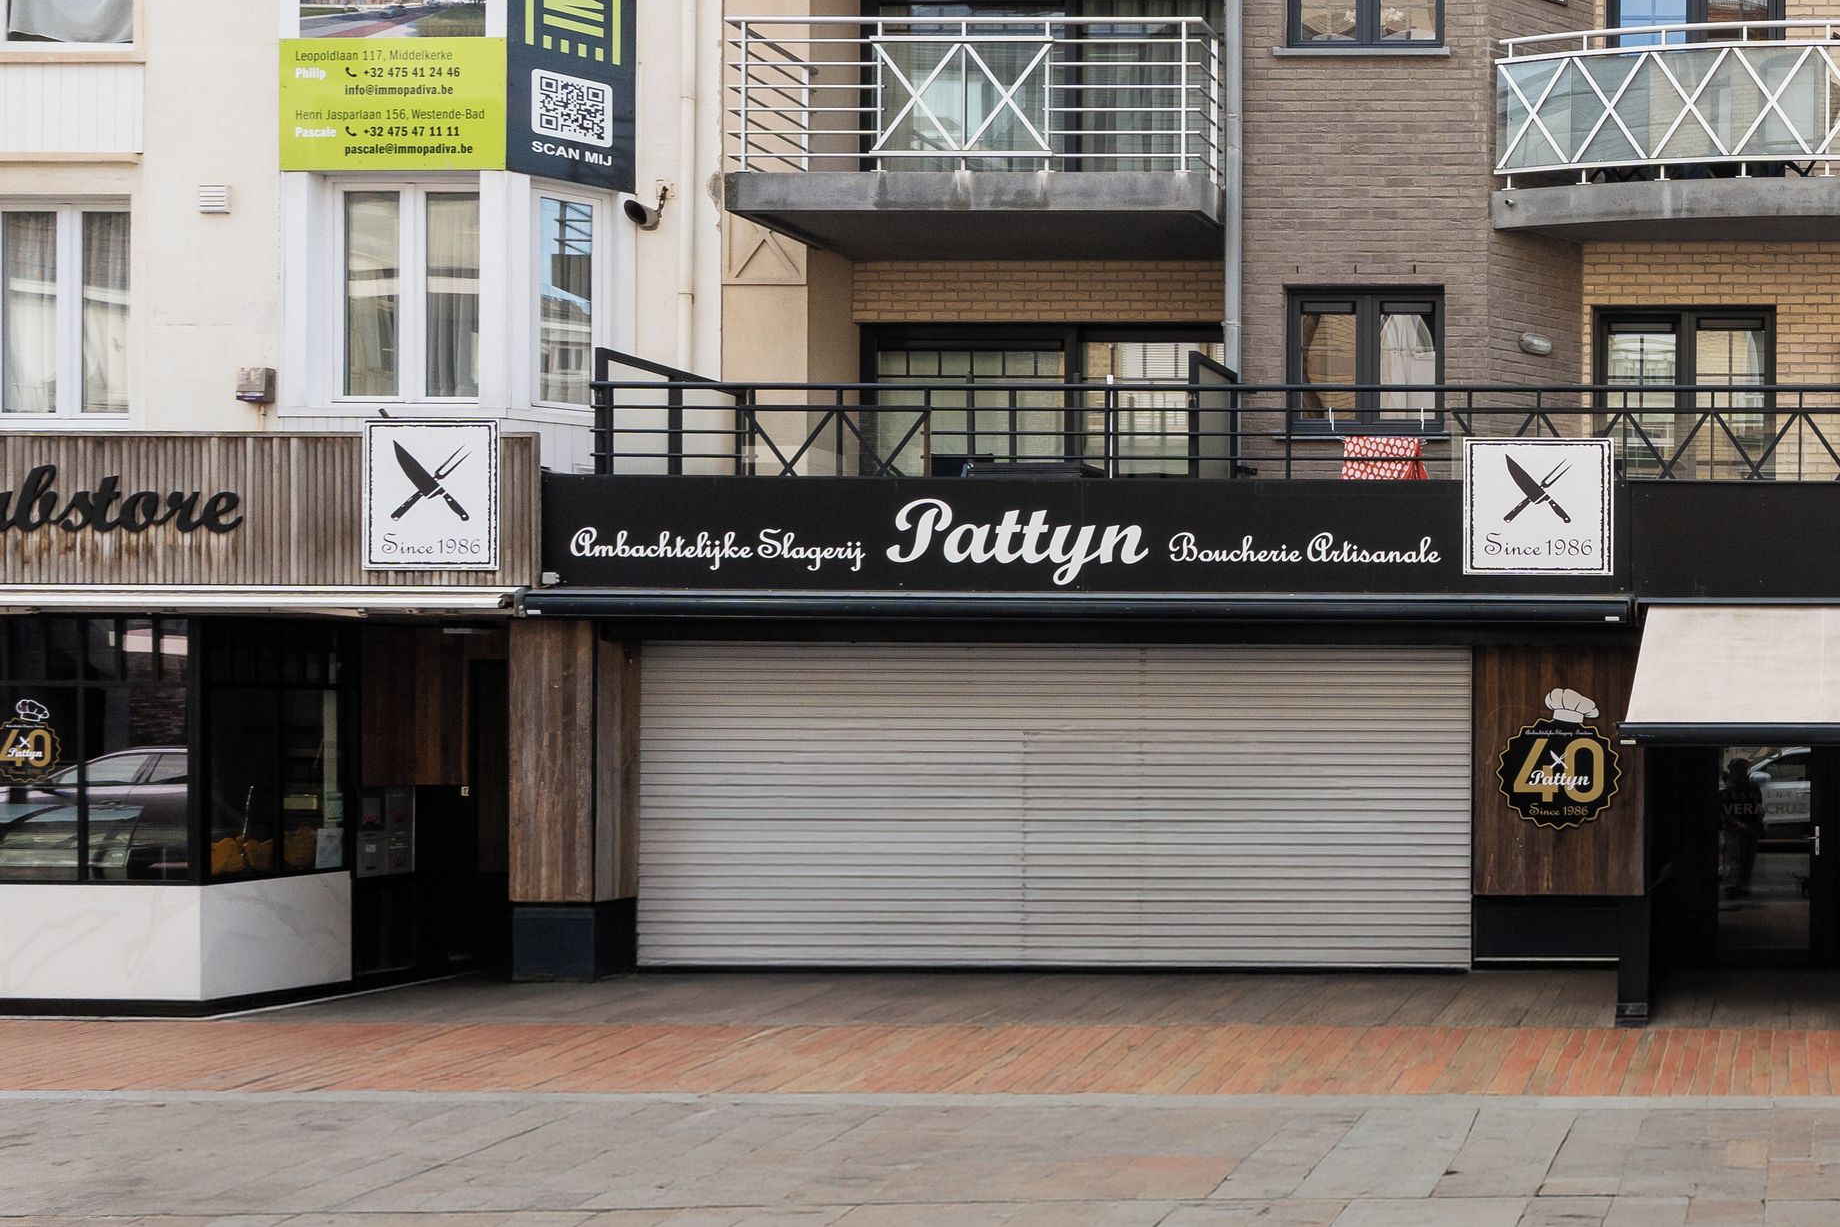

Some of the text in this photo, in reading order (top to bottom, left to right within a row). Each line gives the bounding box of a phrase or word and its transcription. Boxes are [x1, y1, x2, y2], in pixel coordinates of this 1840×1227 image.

[295, 50, 359, 63] Leopoldlaan
[389, 49, 453, 61] Middelkerke
[295, 67, 460, 80] Philip +32 475 41 24 46
[345, 85, 454, 97] info@immopadiva.be
[295, 109, 322, 120] Henri
[326, 109, 382, 122] Jasparlaan
[411, 108, 485, 120] Westende-Bad
[295, 127, 460, 138] Pascale +32 475 47 11 11
[345, 144, 473, 157] pascale@immopadiva.be
[531, 140, 612, 166] SCAN MIJ
[381, 533, 481, 554] Since 1986
[569, 498, 1441, 585] Ambachtelijke Slagerij Pattyn Boucherie Artisanale
[1483, 532, 1594, 556] Since 1986
[1513, 738, 1604, 803] 40
[1529, 769, 1591, 791] Pattyn
[1529, 802, 1589, 816] Since 1986
